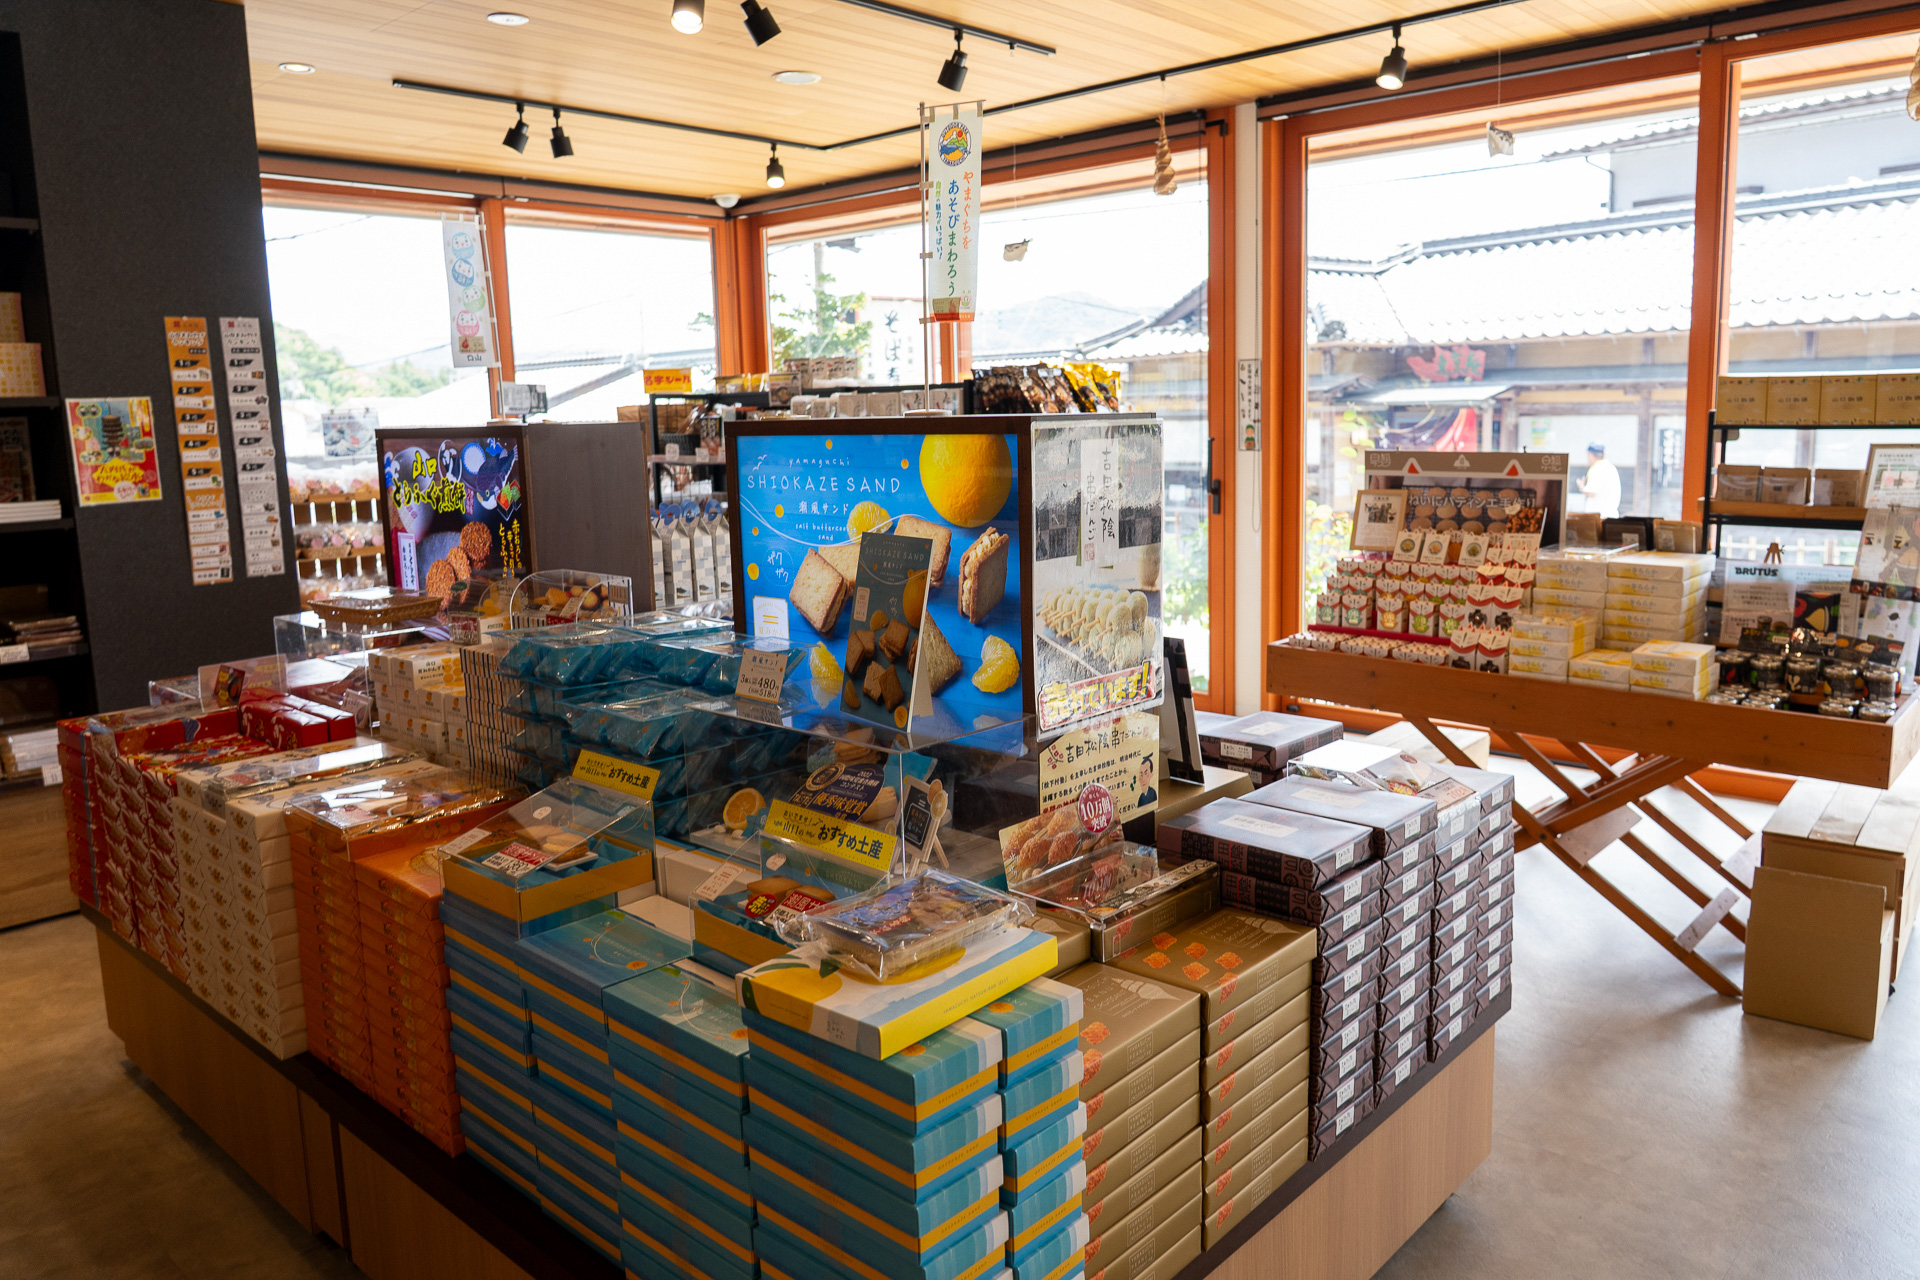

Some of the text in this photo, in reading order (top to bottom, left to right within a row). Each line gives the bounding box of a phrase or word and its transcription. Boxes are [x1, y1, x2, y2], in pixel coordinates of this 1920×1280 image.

[962, 171, 974, 250] やまぐちを
[947, 179, 960, 297] あそびまわろう
[412, 450, 438, 480] 山口
[788, 456, 851, 469] yamaguchi
[747, 474, 900, 494] SHIOKAZE SAND
[798, 500, 850, 516] 潮風サンド
[795, 522, 810, 532] salt
[817, 532, 835, 542] sand
[903, 553, 925, 562] SAND
[1735, 566, 1779, 577] BRUTUS
[1042, 661, 1151, 718] 売れています!
[608, 767, 651, 790] おすすめ土産
[817, 824, 884, 860] おすすめ土産
[783, 892, 821, 911] 潮風サ
